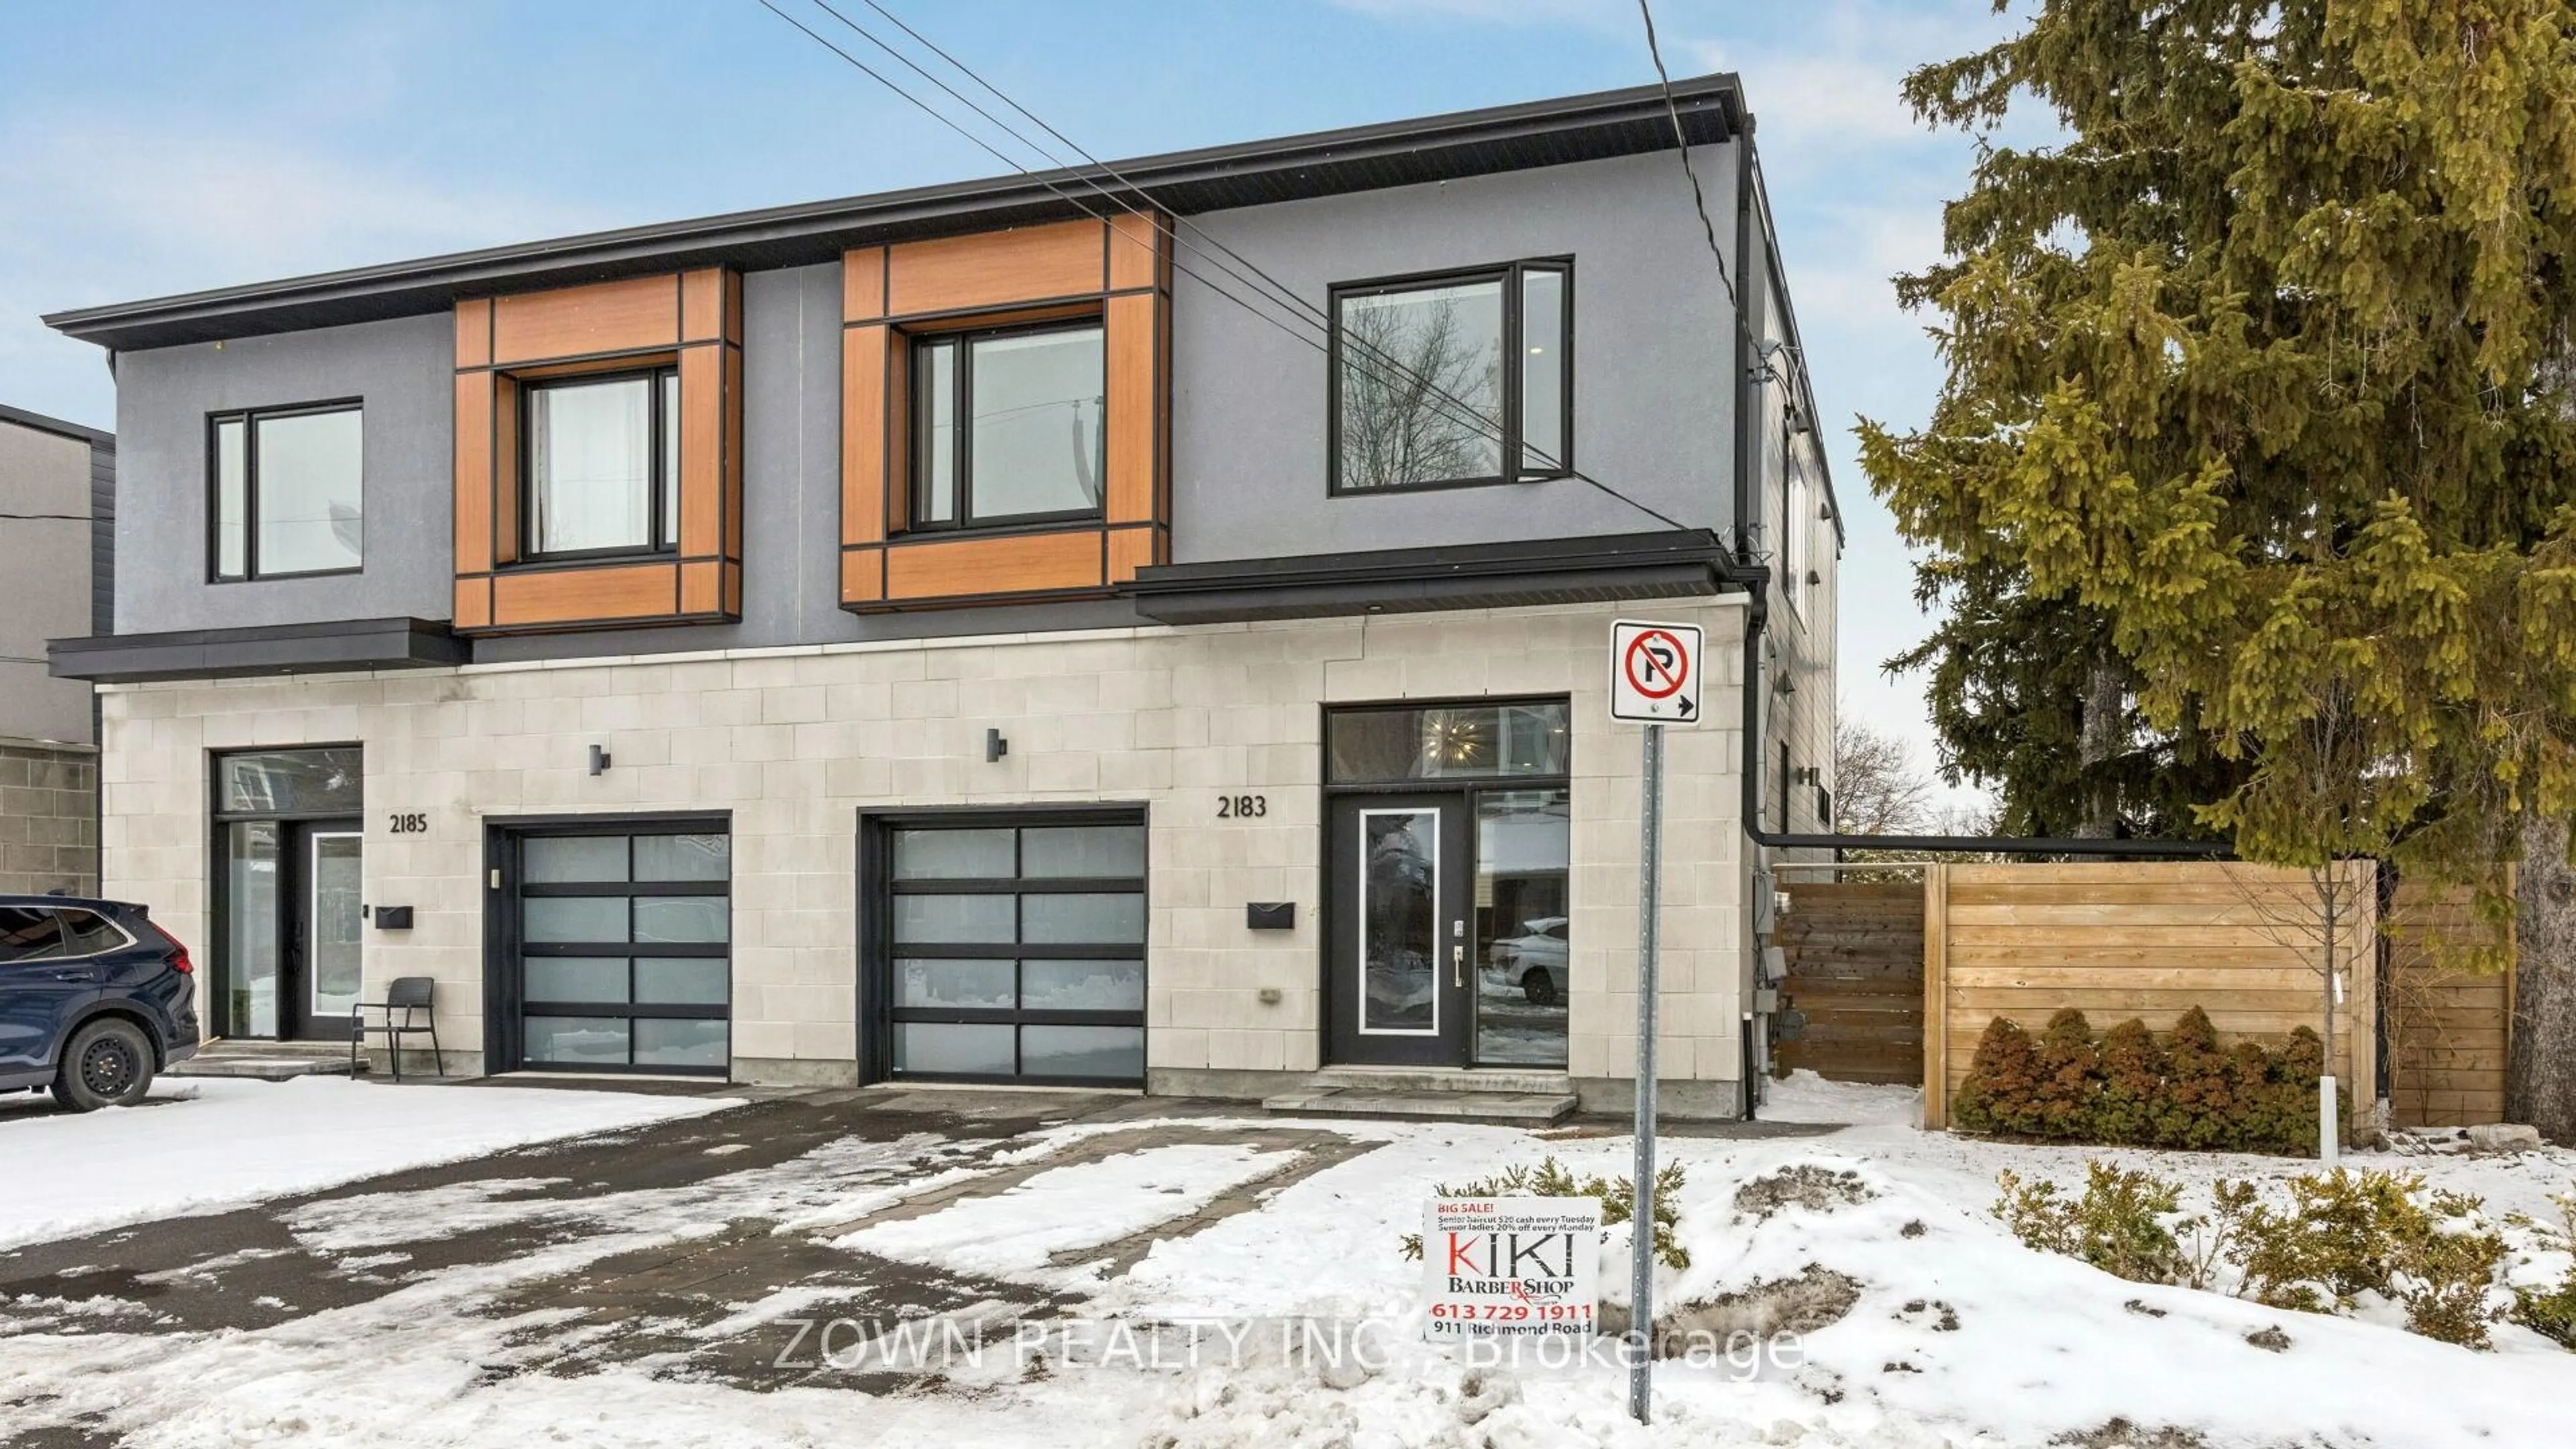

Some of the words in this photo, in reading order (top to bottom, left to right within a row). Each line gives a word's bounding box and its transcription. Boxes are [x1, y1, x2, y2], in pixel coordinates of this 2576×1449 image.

[1216, 796, 1266, 818] 2183
[390, 813, 427, 833] 2185
[1438, 1203, 1458, 1212] BIG
[1461, 1203, 1493, 1212] SALE!
[1536, 1216, 1559, 1224] every
[1560, 1216, 1595, 1224] Tuesday
[1559, 1224, 1595, 1232] Monday
[1447, 1232, 1574, 1278] KIKI
[1432, 1304, 1476, 1319] 613
[1484, 1305, 1529, 1320] 729
[1537, 1304, 1591, 1320] 1911
[1434, 1321, 1461, 1334] 911
[1467, 1322, 1548, 1335] Richmond
[1552, 1321, 1592, 1335] Road
